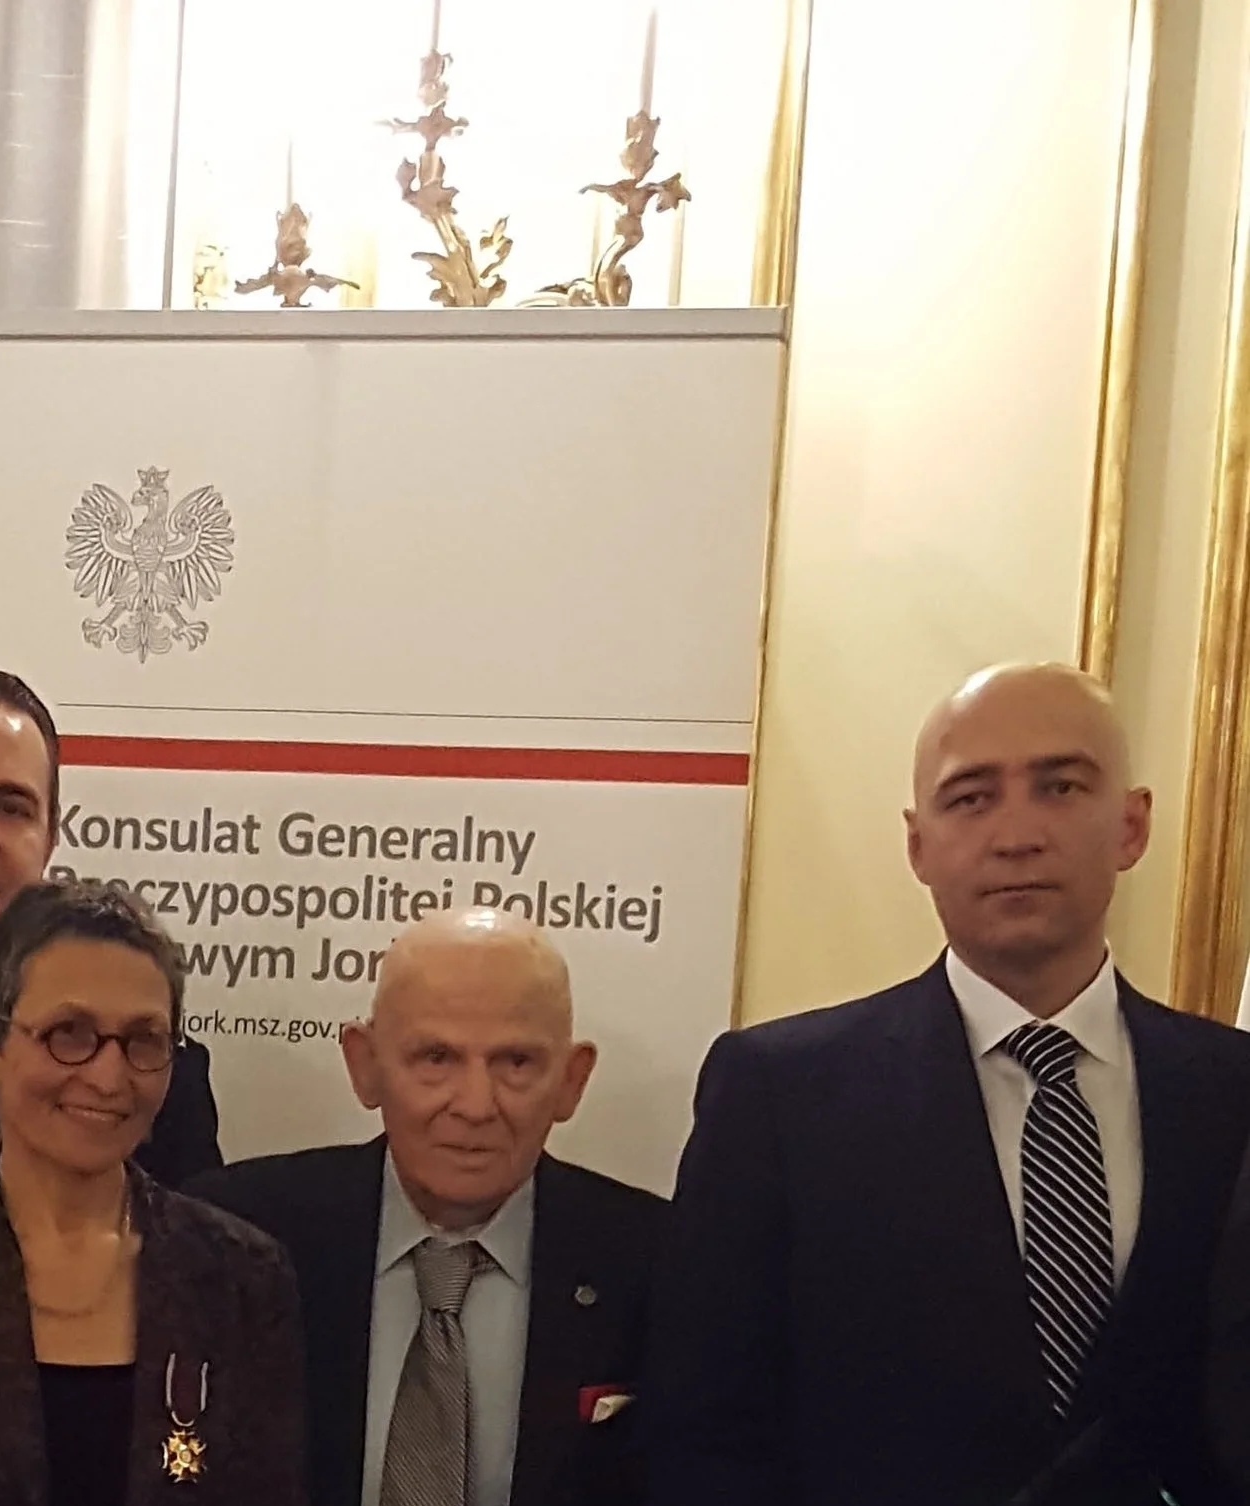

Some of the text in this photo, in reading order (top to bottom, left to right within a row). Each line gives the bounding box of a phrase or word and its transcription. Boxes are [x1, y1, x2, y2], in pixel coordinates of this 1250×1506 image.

[59, 804, 536, 875] Konsulat Generalny
[49, 865, 453, 929] czypospolitej
[175, 938, 396, 988] wym Jor
